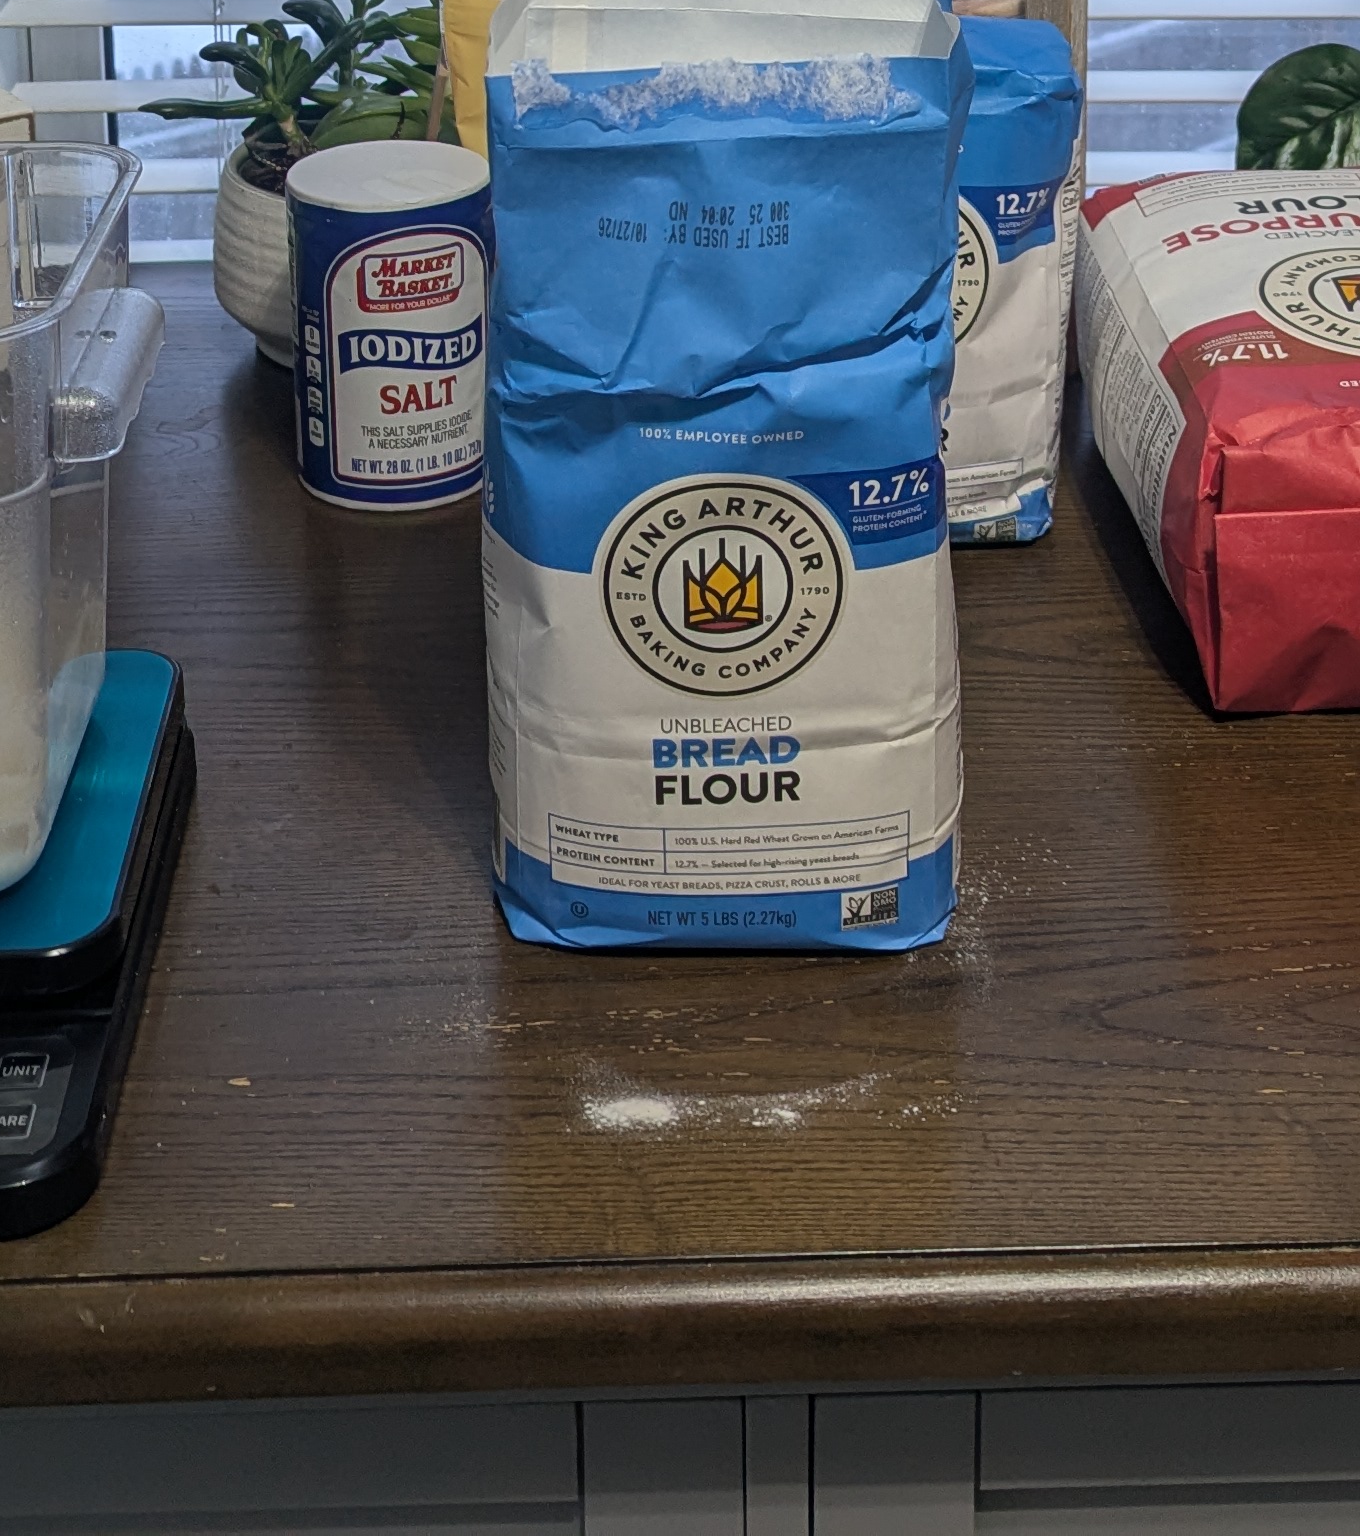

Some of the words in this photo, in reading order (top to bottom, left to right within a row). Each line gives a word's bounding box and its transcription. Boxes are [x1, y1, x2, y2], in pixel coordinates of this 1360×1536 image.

[668, 200, 689, 222] ND
[995, 187, 1050, 215] 12.7%
[749, 203, 764, 225] 25
[598, 216, 647, 243] 10/27/26
[693, 226, 729, 248] USED
[736, 227, 751, 249] IF
[758, 224, 789, 248] BEST
[371, 251, 457, 278] MARKET
[349, 329, 477, 365] IODIZED
[1201, 344, 1289, 367] 11.7%
[379, 375, 458, 415] SALT
[361, 425, 381, 438] THIS
[383, 425, 405, 438] SALT
[407, 419, 448, 437] SUPPLIES
[639, 426, 672, 440] 100%
[675, 429, 748, 444] EMPLOYEE
[751, 430, 805, 444] OWNED
[368, 438, 375, 449] A
[377, 436, 430, 450] NECESSARY
[351, 457, 368, 473] NET
[427, 455, 440, 470] LB.
[442, 451, 453, 467] 10
[1150, 425, 1178, 520] Nutrition
[848, 467, 929, 507] 12.7%
[852, 504, 922, 524] GLUTEN-FORMING
[620, 508, 687, 580] KING
[697, 496, 824, 575] ARTHUR
[852, 522, 888, 532] PROTEIN
[616, 591, 647, 602] ESTD
[800, 586, 830, 596] 1790
[629, 614, 706, 677] BAKING
[718, 607, 818, 679] COMPANY
[660, 715, 792, 734] UNBLEACHED
[652, 735, 801, 769] BREAD
[655, 770, 801, 805] FLOUR
[555, 824, 591, 839] WHEAT
[593, 831, 619, 842] TYPE
[675, 837, 698, 846] 100%
[701, 837, 719, 846] U.S.
[744, 836, 760, 844] Red
[762, 835, 790, 844] Wheat
[792, 833, 820, 842] Grown
[833, 828, 873, 839] American
[874, 824, 899, 835] Farms
[556, 846, 602, 863] PROTEIN
[603, 855, 656, 867] CONTENT
[598, 876, 627, 887] IDEAL
[628, 879, 649, 888] FOR
[650, 880, 680, 889] YEAST
[682, 881, 723, 891] BREADS,
[725, 880, 753, 890] PIZZA
[754, 879, 789, 890] CRUST,
[790, 876, 821, 888] ROLLS
[832, 873, 861, 884] MORE
[873, 889, 896, 900] NON
[647, 910, 673, 926] NET
[676, 910, 697, 926] WT
[701, 910, 709, 926] 5
[713, 911, 739, 926] LBS
[743, 910, 797, 928] (2.27kg)
[2, 1064, 41, 1077] UNIT
